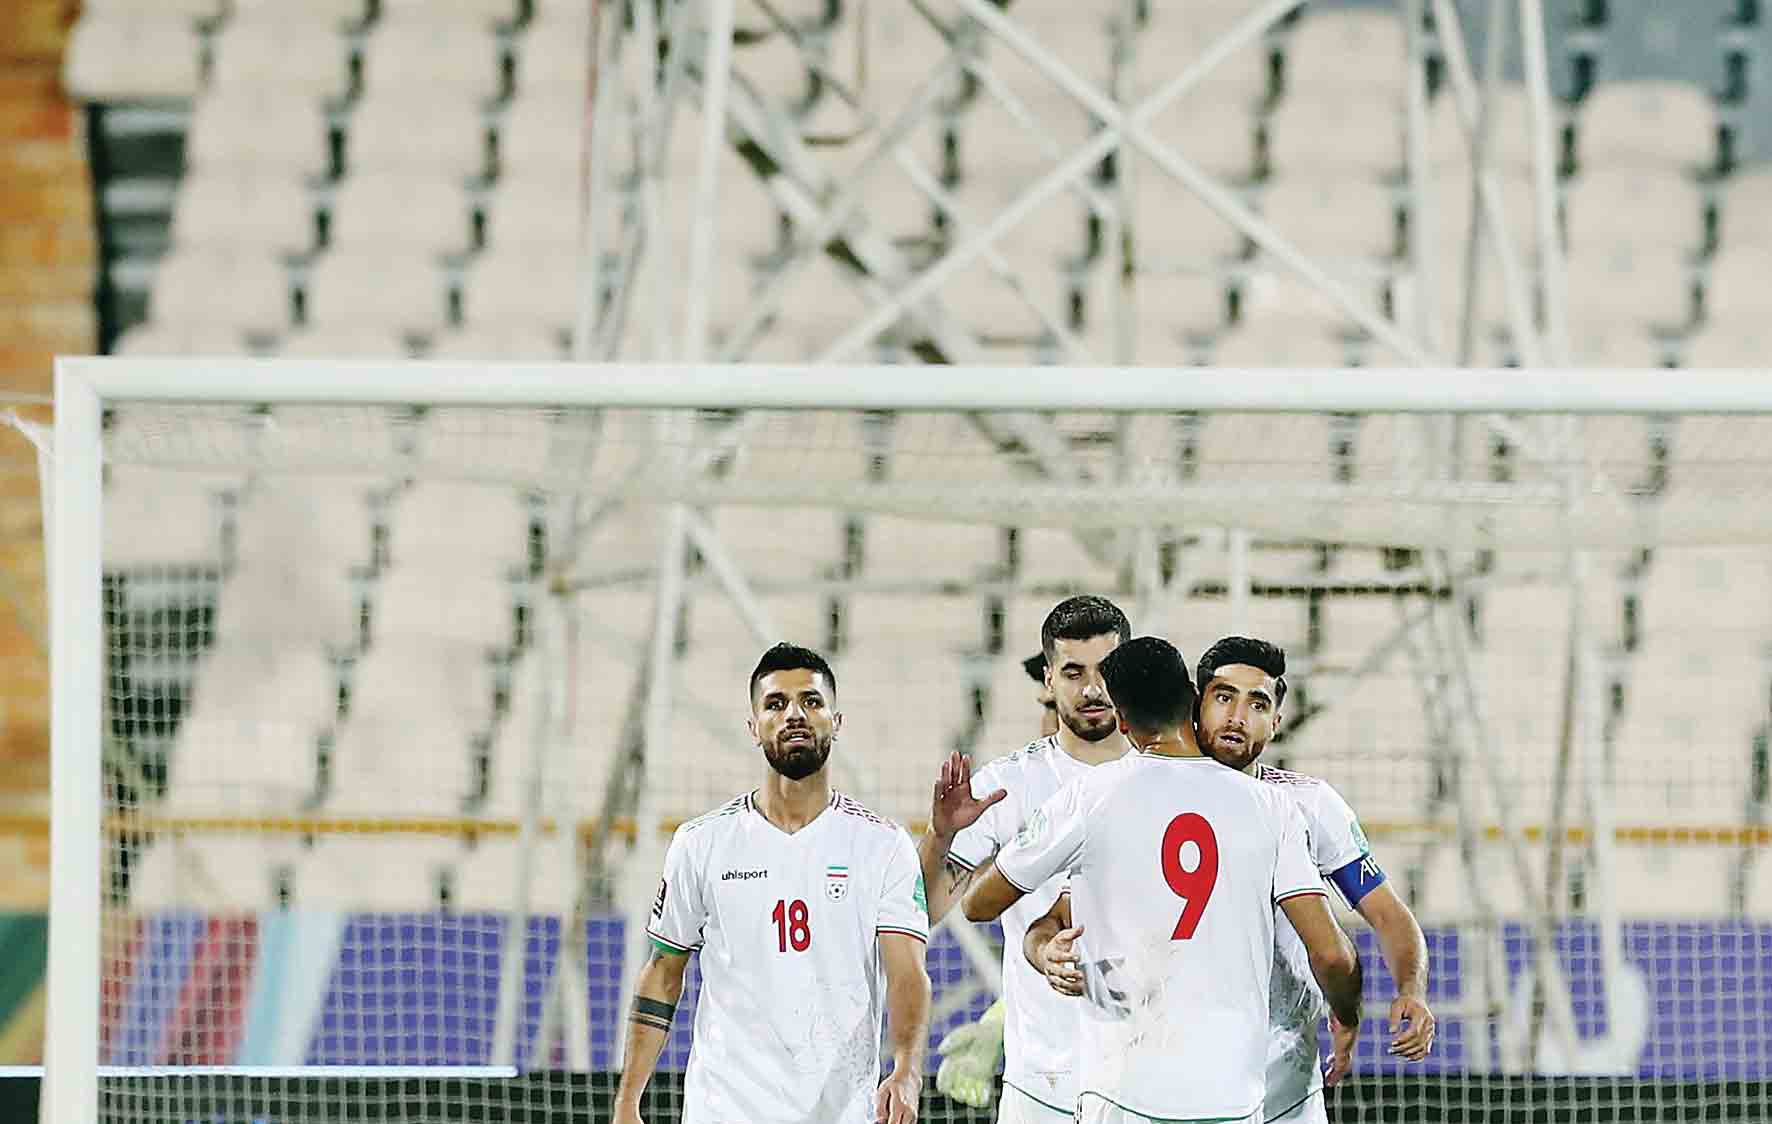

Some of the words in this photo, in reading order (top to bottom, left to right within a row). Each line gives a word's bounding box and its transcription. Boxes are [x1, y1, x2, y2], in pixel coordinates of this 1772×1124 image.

[721, 869, 768, 881] uhlsport
[1161, 812, 1219, 940] 9
[772, 900, 811, 952] 18
